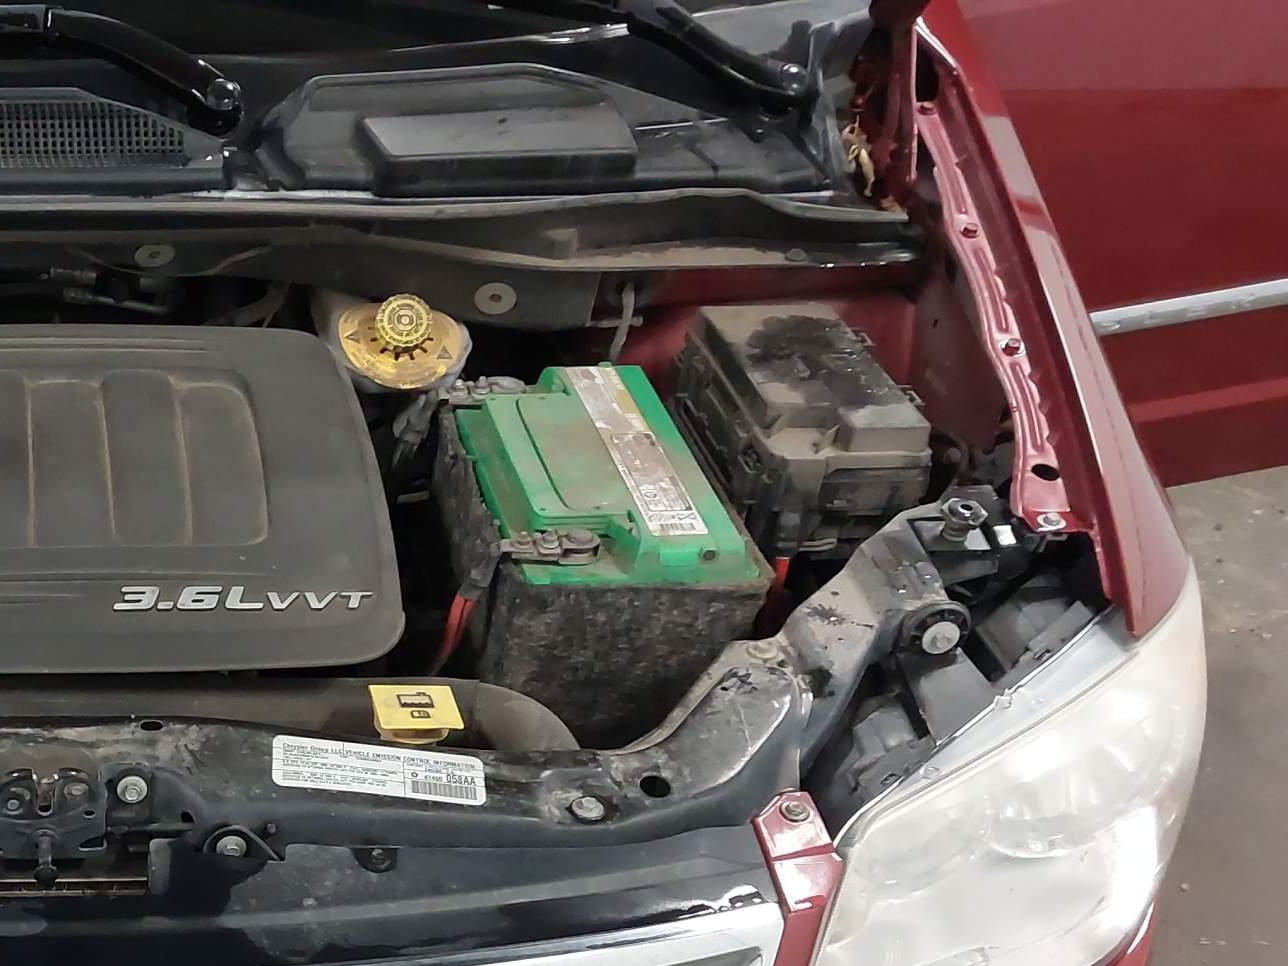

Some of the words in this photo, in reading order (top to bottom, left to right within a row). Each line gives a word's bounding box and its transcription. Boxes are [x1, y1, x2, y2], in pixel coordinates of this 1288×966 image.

[345, 749, 370, 758] VEHICLE
[403, 756, 429, 765] CONTROL
[432, 759, 476, 769] INFORMATION
[446, 773, 477, 786] 058AA
